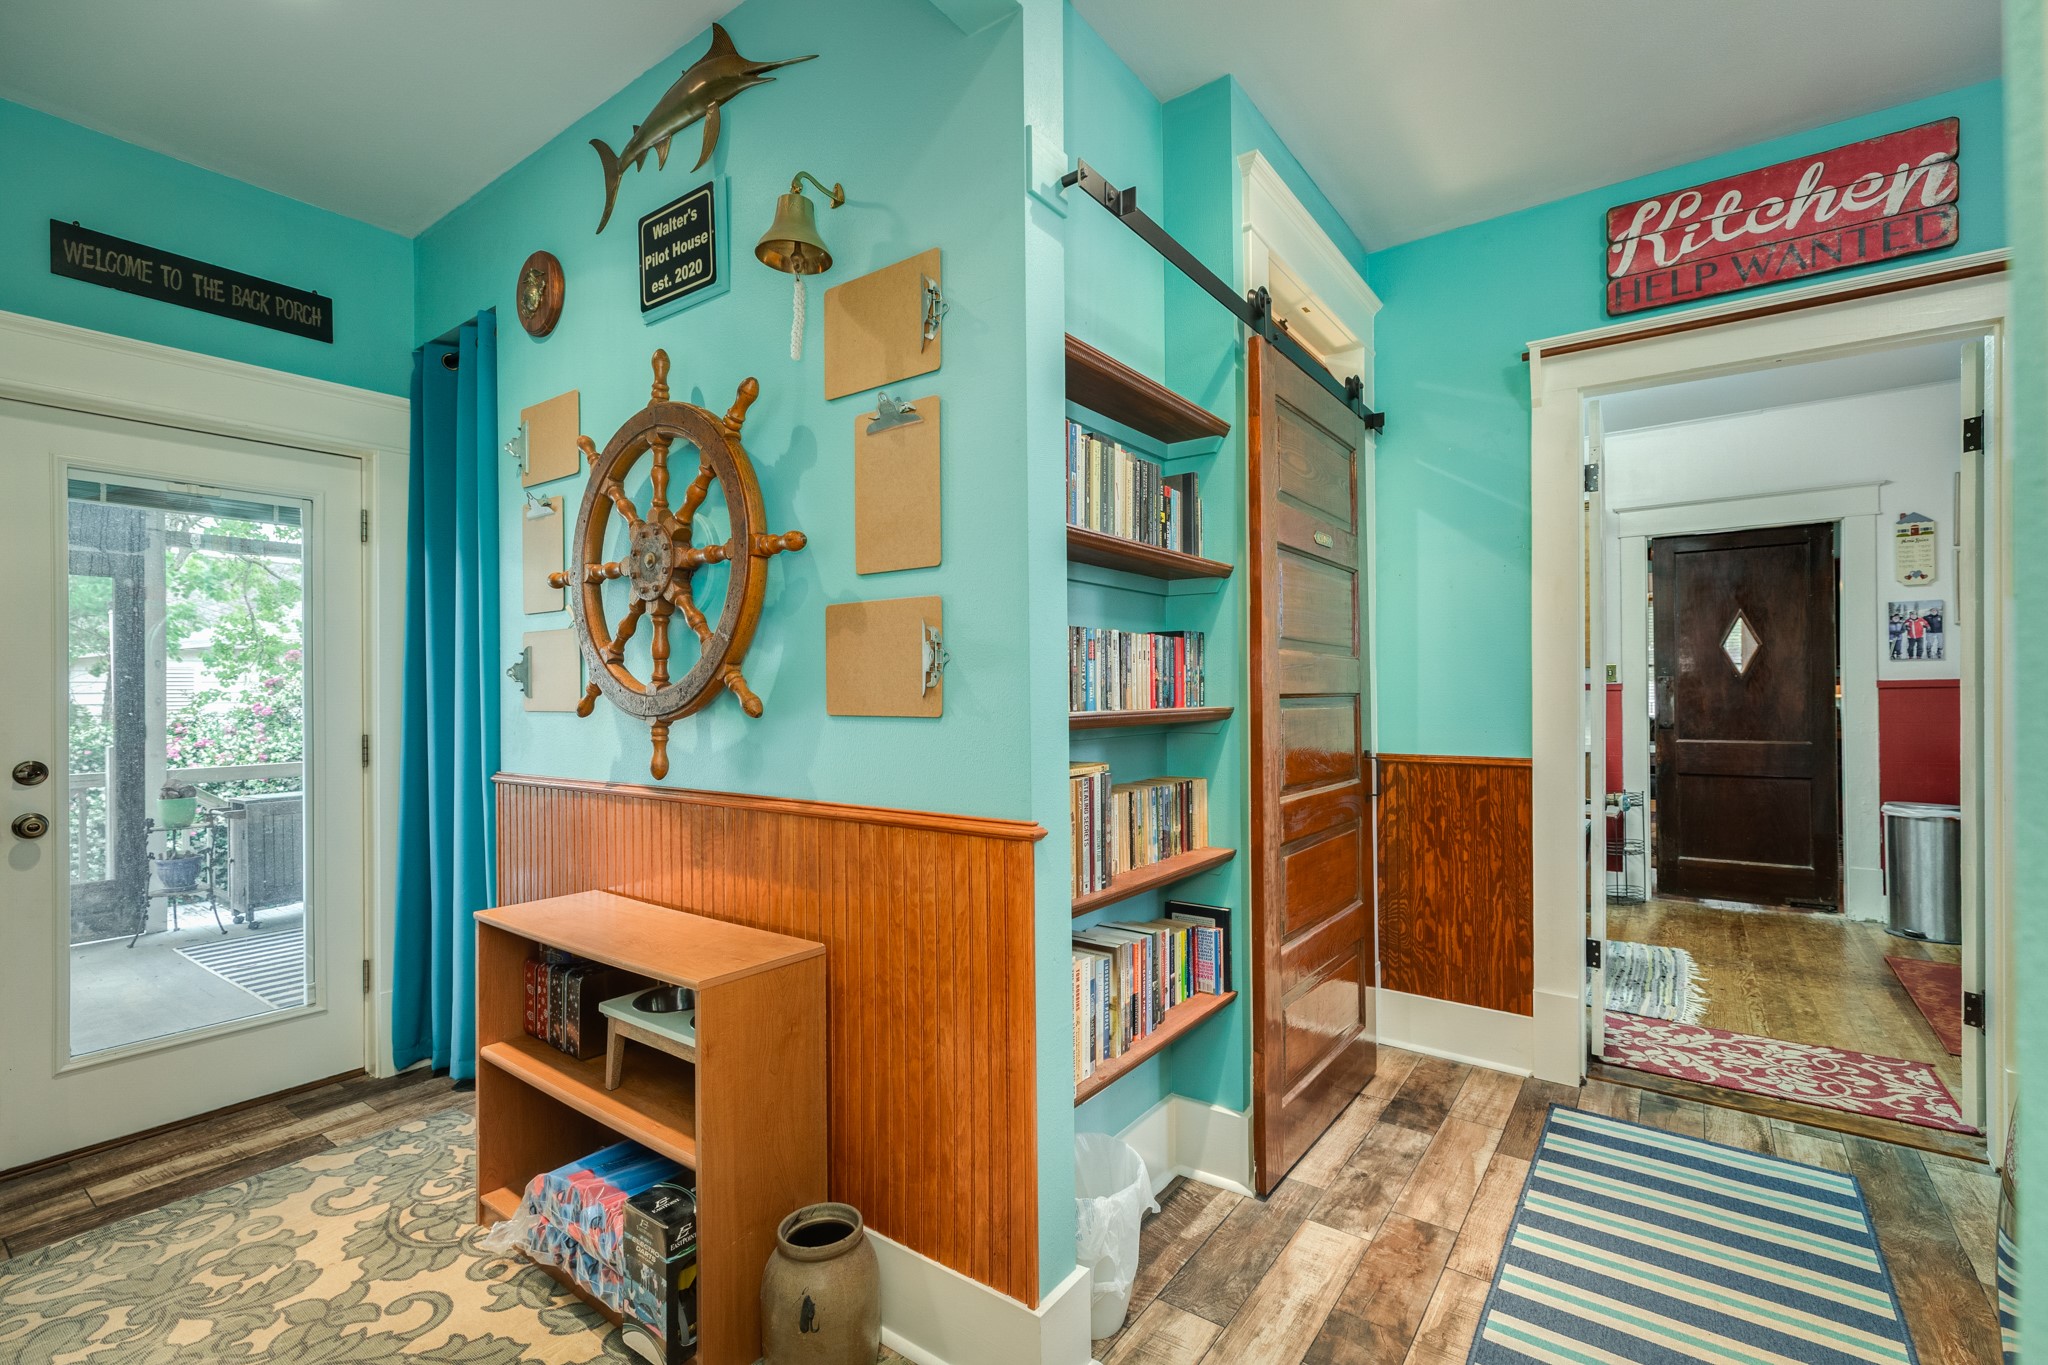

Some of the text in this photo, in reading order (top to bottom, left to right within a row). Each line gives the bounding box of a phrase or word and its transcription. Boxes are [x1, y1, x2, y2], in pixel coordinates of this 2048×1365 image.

[652, 207, 698, 240] Walter's
[1611, 152, 1959, 278] Kitchen
[645, 231, 708, 271] Pilot House
[1615, 211, 1953, 309] HELP WANTED
[63, 238, 322, 328] WELCOME TO THE BACK PORCH
[651, 258, 703, 294] est. 2020
[631, 1236, 661, 1259] ELECTRO
[635, 1245, 657, 1264] DARTS
